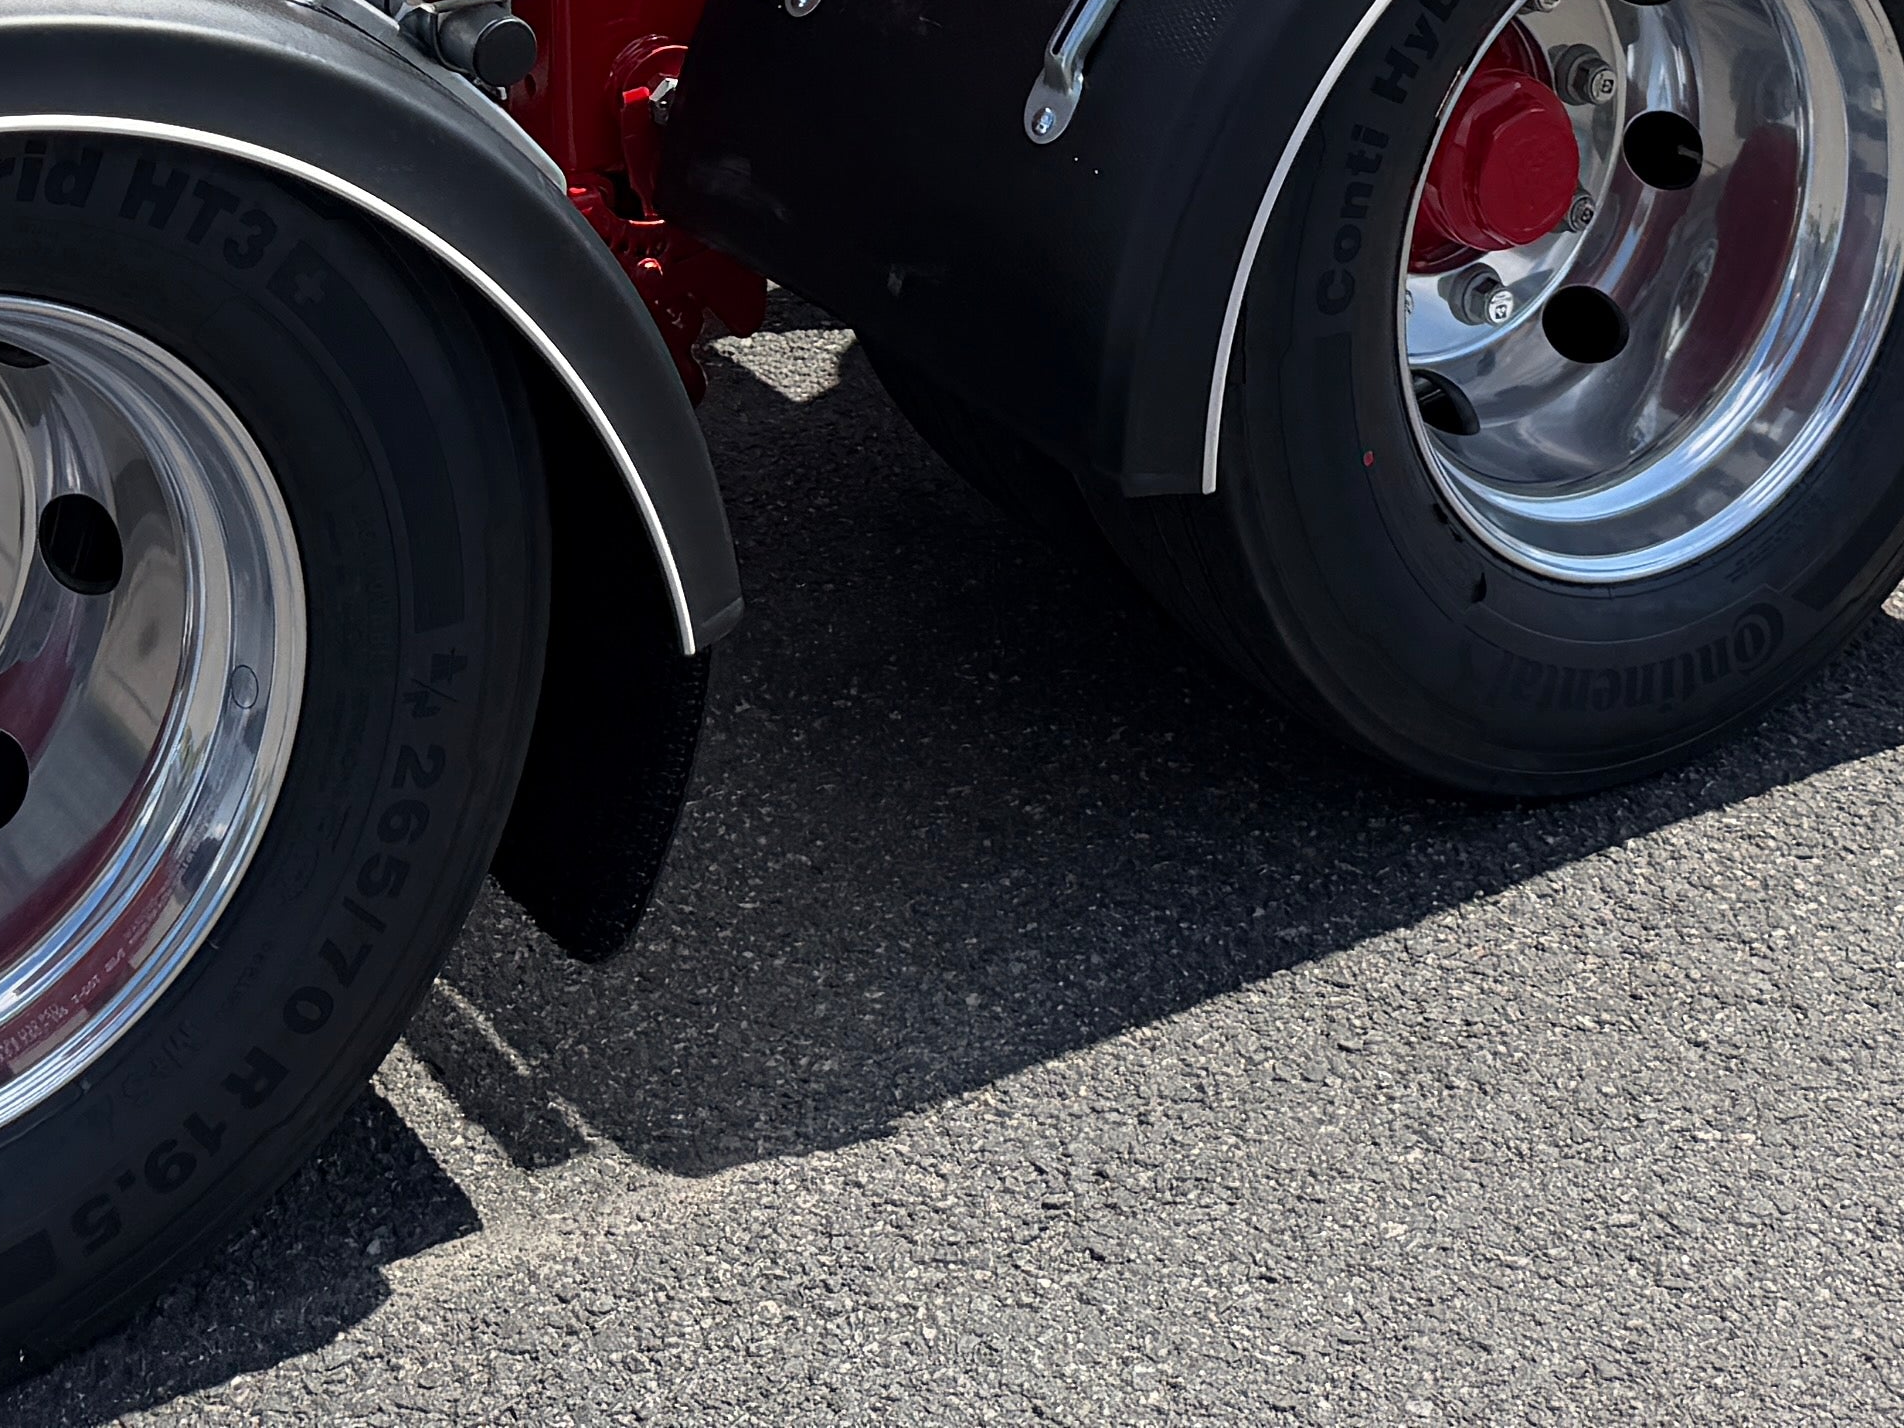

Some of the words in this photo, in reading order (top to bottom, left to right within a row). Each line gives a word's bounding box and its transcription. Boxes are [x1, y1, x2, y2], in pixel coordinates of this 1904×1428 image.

[1316, 123, 1390, 317] Conti
[282, 743, 447, 1035] 265/70
[219, 1045, 291, 1111] R
[69, 1112, 228, 1258] 19.5
